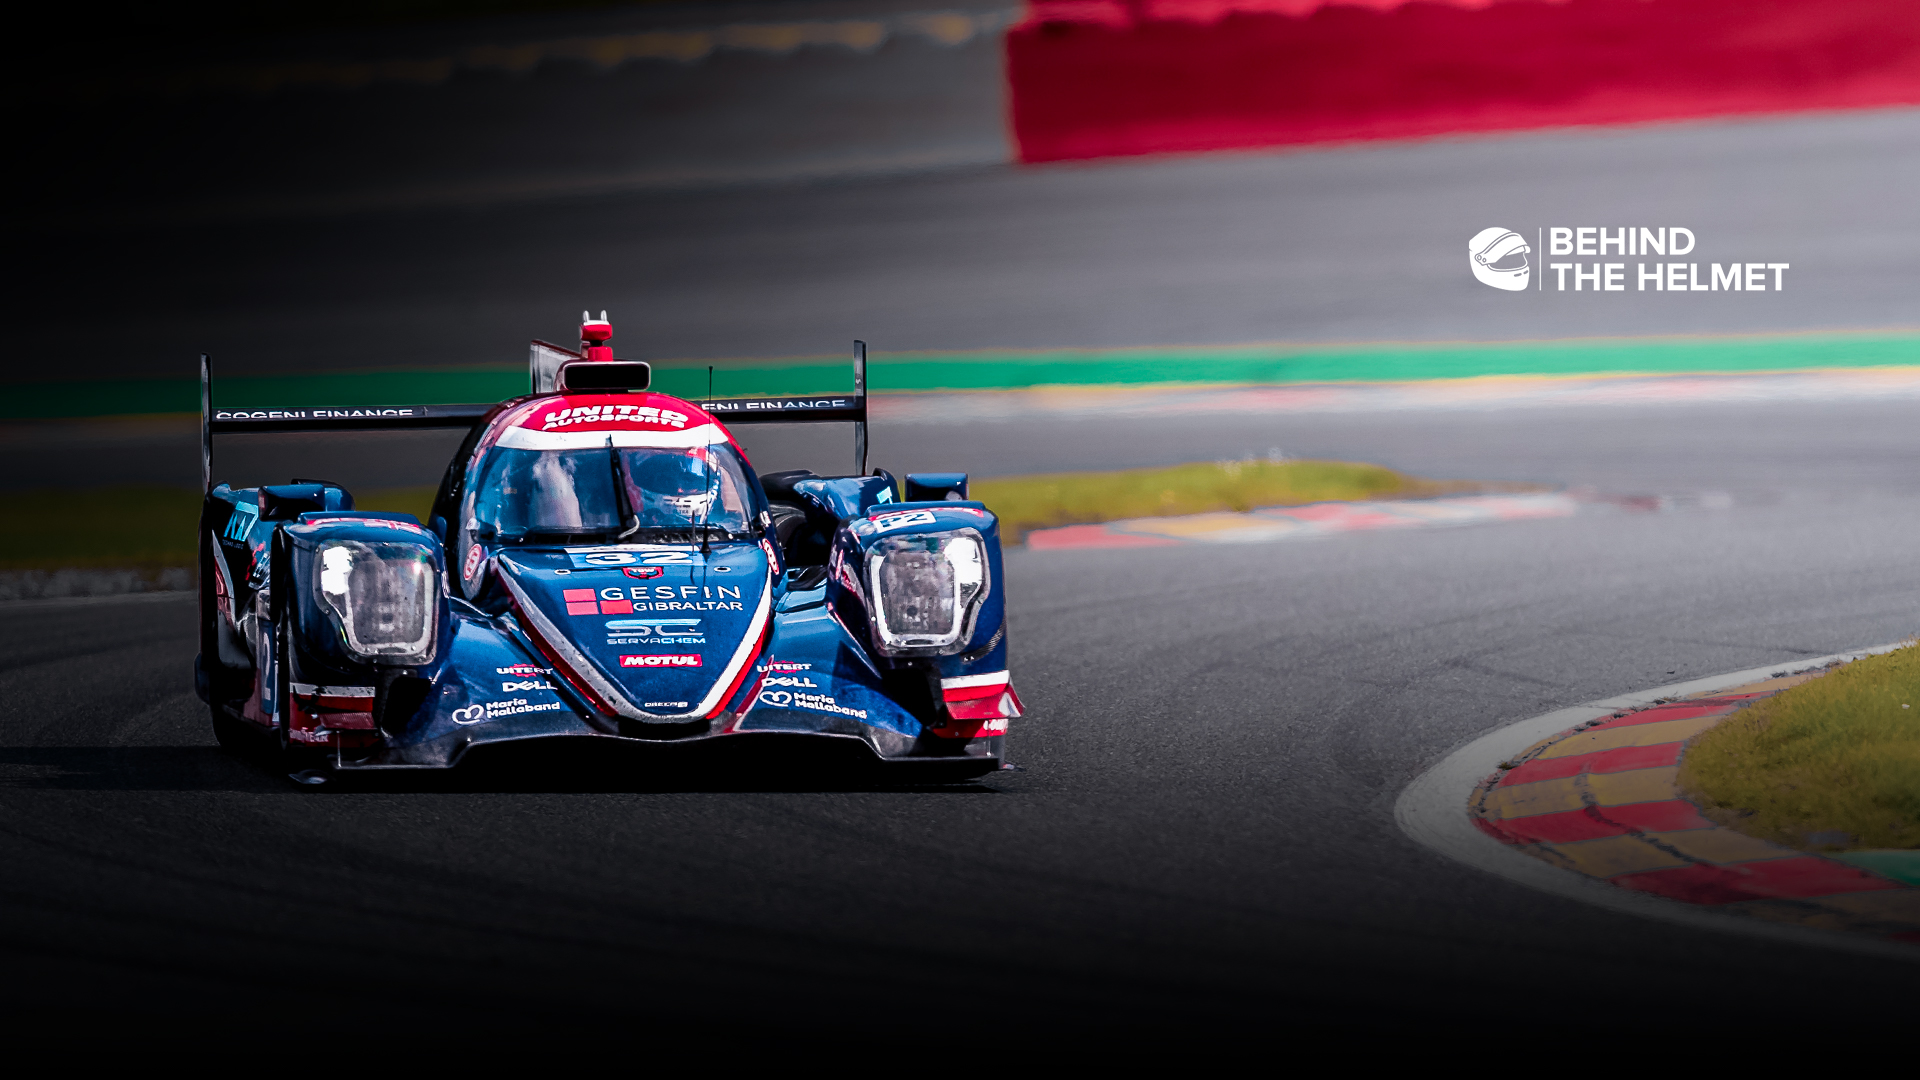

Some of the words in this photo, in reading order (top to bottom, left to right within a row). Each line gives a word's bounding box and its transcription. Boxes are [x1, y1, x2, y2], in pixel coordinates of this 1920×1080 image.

[544, 405, 689, 423] UNITED
[542, 414, 686, 431] AUTOSPORTS
[585, 551, 693, 565] 32
[600, 585, 741, 600] GESFIN
[633, 601, 743, 611] GIBRALTAR
[607, 637, 706, 645] SERVACHEM
[624, 655, 698, 666] MOTUL
[496, 667, 554, 675] UITERT
[757, 663, 812, 673] UITERT
[502, 680, 558, 692] DELL
[761, 677, 818, 688] DELL
[793, 692, 835, 704] Maria
[486, 698, 527, 711] Maria
[486, 701, 561, 719] Mallaband
[794, 700, 868, 720] Mallaband
